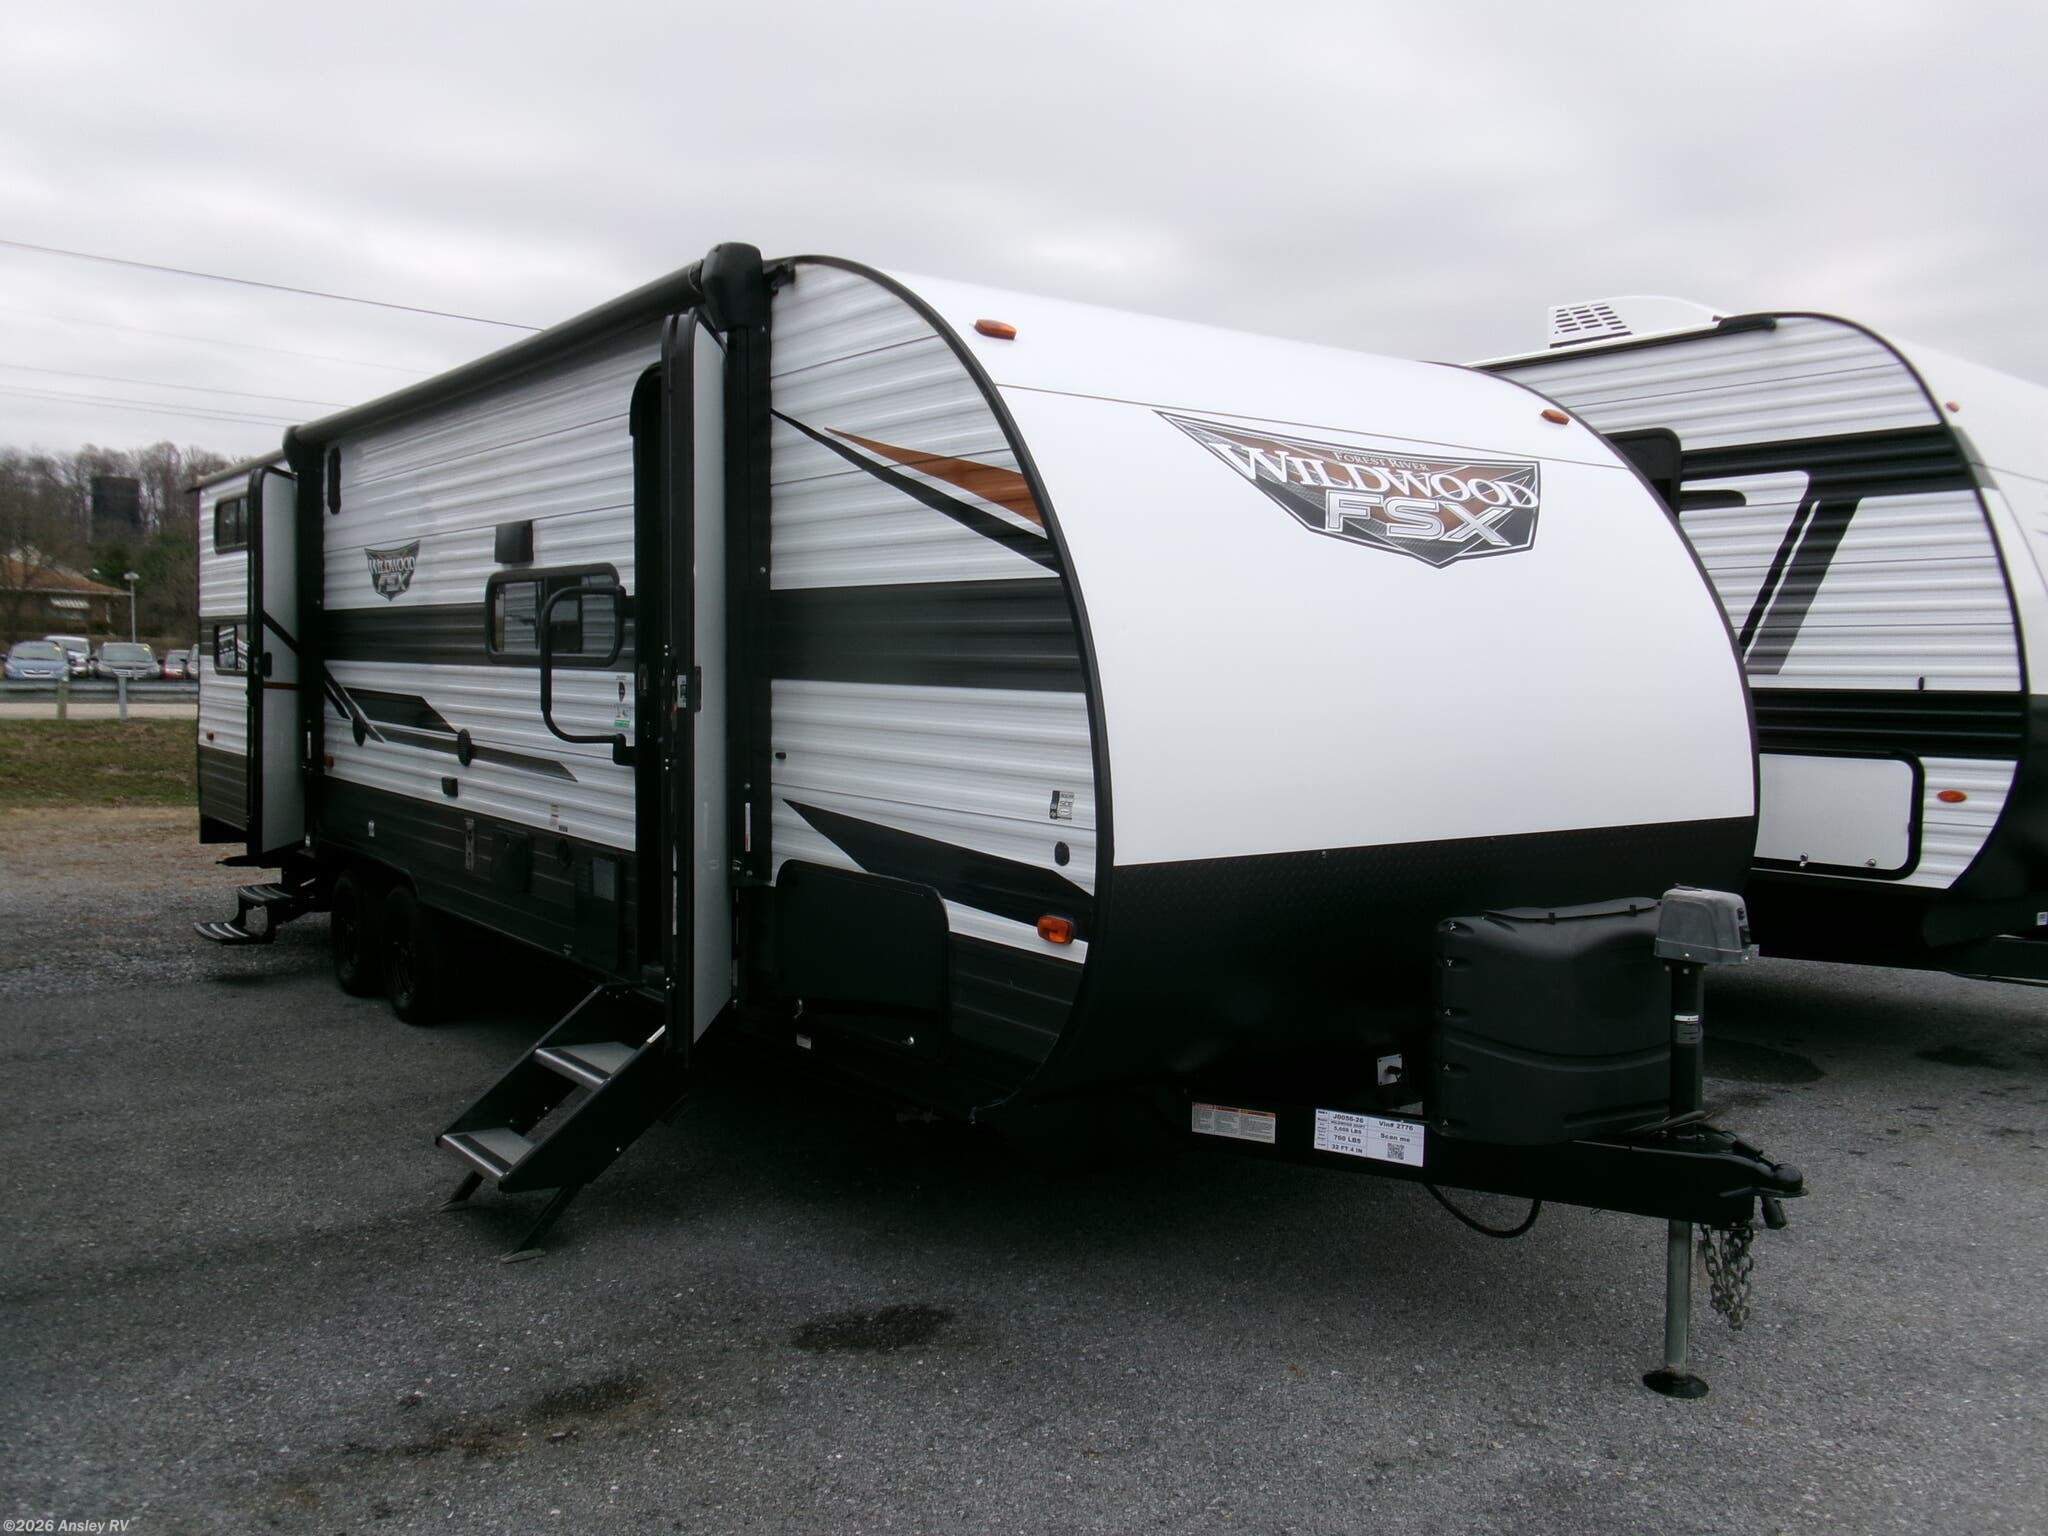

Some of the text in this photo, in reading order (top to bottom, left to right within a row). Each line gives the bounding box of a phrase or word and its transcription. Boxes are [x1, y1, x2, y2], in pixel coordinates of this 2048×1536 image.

[1208, 442, 1539, 508] WILDWOOD
[1334, 452, 1431, 471] FOREST RIVER
[1324, 489, 1512, 547] FSX
